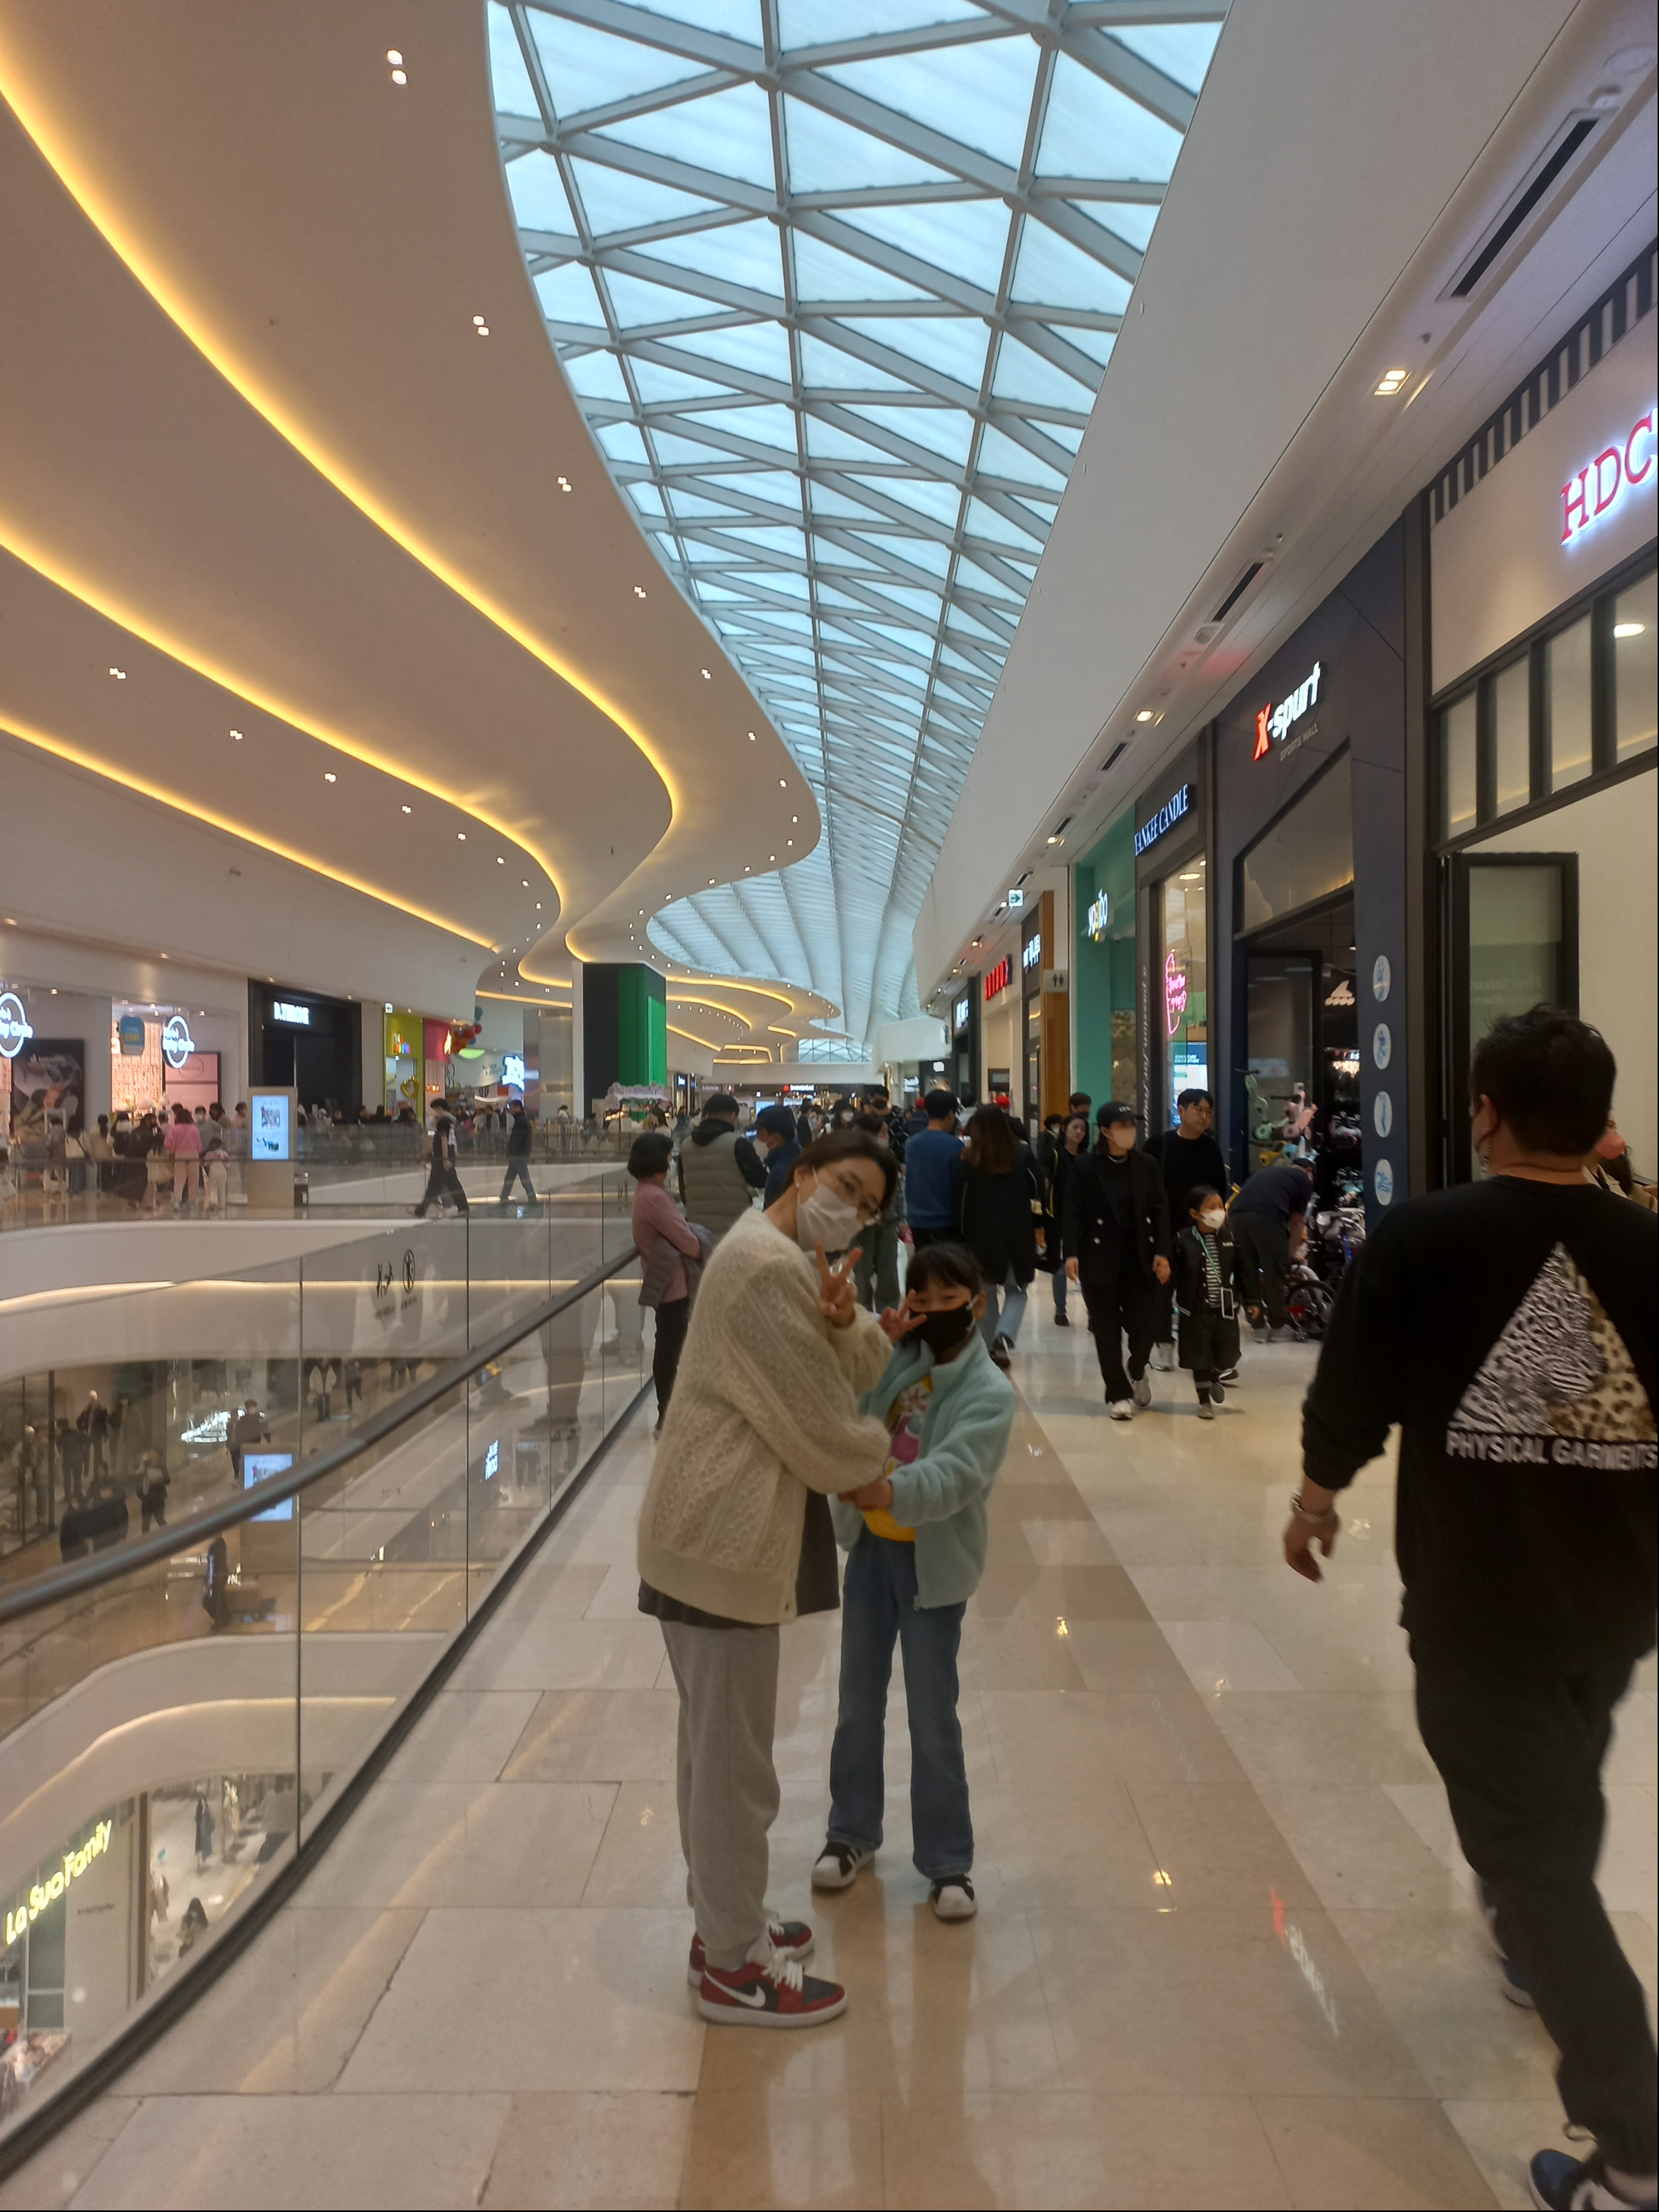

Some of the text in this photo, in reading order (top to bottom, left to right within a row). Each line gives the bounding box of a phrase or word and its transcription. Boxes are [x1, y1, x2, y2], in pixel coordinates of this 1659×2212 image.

[1560, 408, 1658, 546] HDC
[1159, 783, 1188, 834] CANDLE
[1446, 1431, 1549, 1464] PHYSICAL
[5, 1906, 28, 1946] La
[29, 1871, 64, 1921] Sua
[63, 1819, 112, 1887] Family
